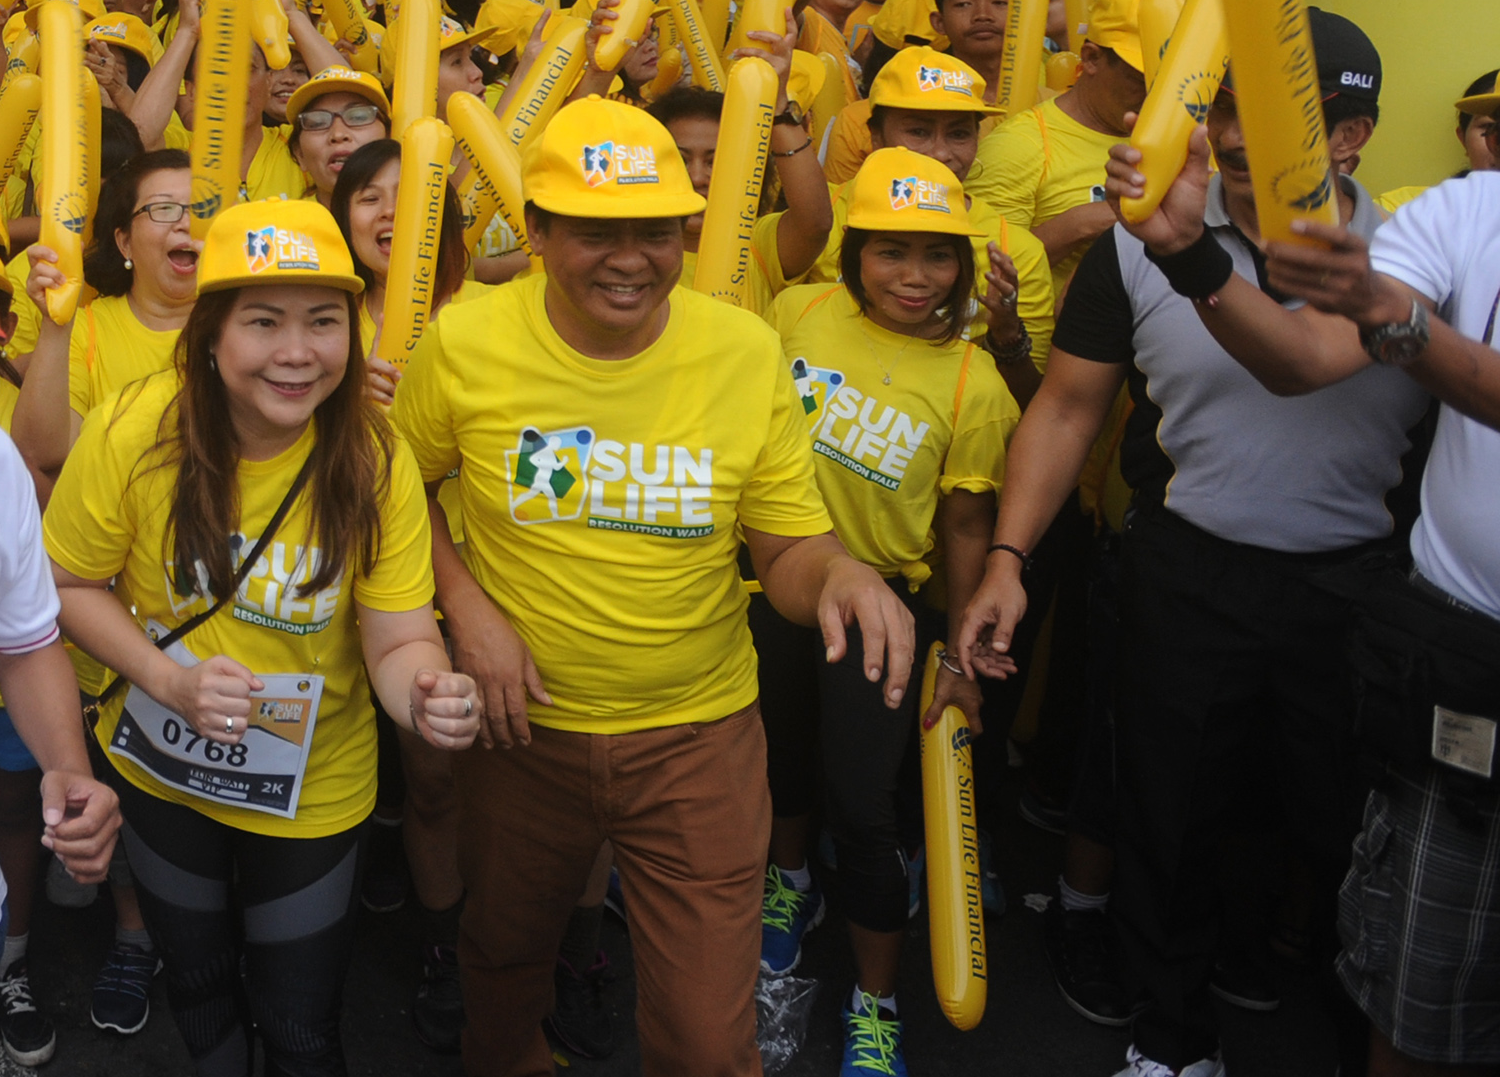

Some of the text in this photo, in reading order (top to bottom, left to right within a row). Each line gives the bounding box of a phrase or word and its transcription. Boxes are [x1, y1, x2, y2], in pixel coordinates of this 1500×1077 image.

[345, 0, 356, 20] Sun
[694, 43, 711, 69] Life
[1003, 40, 1018, 71] Life
[515, 46, 573, 126] Financial
[999, 75, 1013, 106] Sun
[1340, 70, 1374, 90] BALI
[4, 109, 39, 174] Financial
[202, 126, 225, 170] Sun
[616, 145, 655, 161] SUN
[457, 137, 512, 220] Financial
[618, 159, 658, 176] LIFE
[731, 102, 775, 286] Sun Life Financial
[918, 180, 949, 196] SUN
[918, 190, 948, 206] LIFE
[277, 229, 314, 247] SUN
[279, 245, 319, 262] LIFE
[405, 162, 444, 352] Sun Life Financial
[830, 387, 930, 452] SUN
[818, 412, 915, 479] LIFE
[591, 438, 713, 487] SUN
[814, 442, 900, 491] RESOLUTION WALK
[590, 479, 714, 525] LIFE
[588, 519, 714, 537] RESOLUTION WALK
[236, 575, 340, 622] LIFE
[234, 607, 305, 635] RESOLUTION
[275, 711, 301, 720] LIFE
[276, 704, 303, 713] SUN
[162, 718, 249, 768] 0768
[261, 782, 284, 795] 2K
[957, 774, 987, 980] Sun Life Financial
